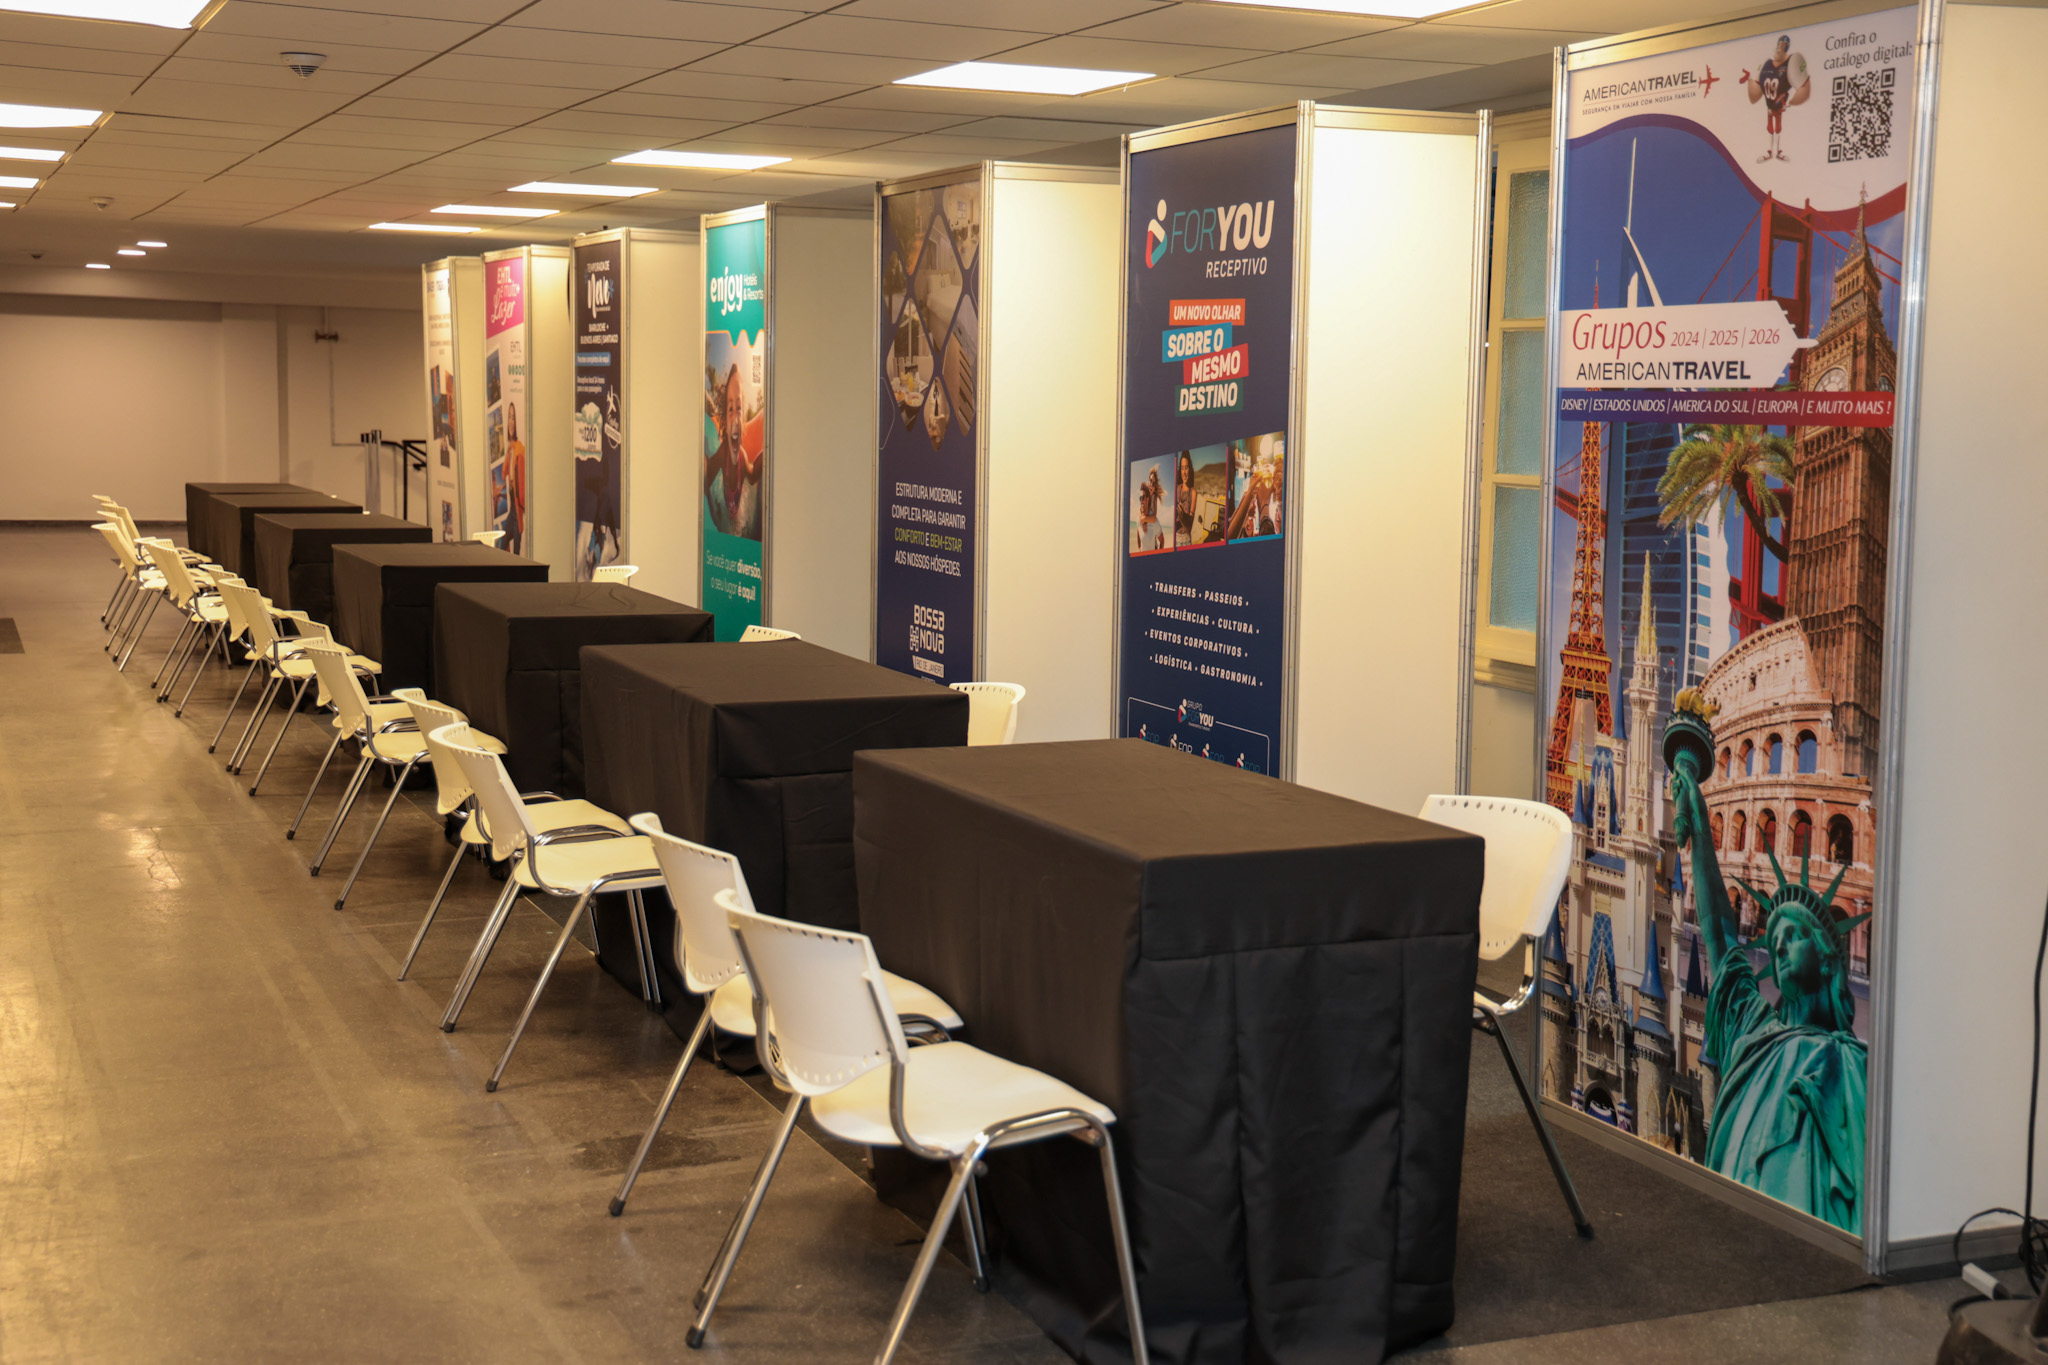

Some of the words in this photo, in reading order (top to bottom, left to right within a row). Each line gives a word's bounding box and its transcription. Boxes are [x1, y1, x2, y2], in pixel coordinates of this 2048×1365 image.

[1825, 32, 1866, 51] Confira
[1869, 32, 1877, 43] o
[1824, 51, 1870, 70] catálogo
[1873, 41, 1913, 64] digital:
[1583, 71, 1697, 102] AMERICANTRAVEL
[1582, 105, 1611, 116] SEGURANÇA
[1622, 101, 1639, 109] VIAJAR
[1655, 95, 1673, 103] NOSSA
[1675, 91, 1696, 100] FAMÍLIA
[1170, 200, 1275, 254] FORYOU
[1206, 256, 1268, 279] RECEPTIVO
[710, 266, 743, 316] enjoy
[1173, 305, 1187, 321] UM
[1187, 305, 1210, 321] NOVO
[1211, 304, 1241, 320] OLHAR
[1167, 329, 1212, 358] SOBRE
[1213, 328, 1224, 352] O
[1572, 313, 1667, 360] Grupos
[1670, 331, 1699, 347] 2024
[1709, 330, 1739, 346] 2025
[1748, 328, 1780, 345] 2026
[1191, 350, 1241, 385] MESMO
[1576, 361, 1751, 381] AMERICANTRAVEL
[1179, 382, 1238, 412] DESTINO
[1560, 398, 1588, 411] DISNEY
[1593, 399, 1631, 412] ESTADOS
[1632, 399, 1665, 412] UNIDOS
[1671, 399, 1712, 413] AMERICA
[1714, 400, 1730, 413] DO
[1731, 400, 1750, 413] SUL
[1757, 400, 1799, 414] EUROPA
[1806, 400, 1814, 414] E
[1815, 400, 1853, 414] MUITO
[895, 482, 928, 500] ESTRUTURA
[928, 486, 958, 505] MODERNA
[957, 490, 962, 506] E
[891, 504, 921, 522] COMPLETA
[921, 508, 937, 525] PARA
[937, 511, 966, 530] GARANTIR
[894, 527, 925, 546] CONFORTO
[925, 532, 930, 547] E
[930, 533, 963, 553] BEM-ESTAR
[894, 549, 907, 565] AOS
[906, 552, 930, 570] NOSSOS
[1155, 581, 1196, 599] TRANSFERS
[1204, 590, 1243, 607] PASSEIOS
[1156, 606, 1210, 626] EXPERIÊNCIAS
[1217, 618, 1253, 635] CULTURA
[1149, 628, 1182, 645] EVENTOS
[1183, 635, 1242, 658] CORPORATIVOS
[1154, 653, 1193, 672] LOGÍSTICA
[1200, 664, 1257, 687] GASTRONOMIA
[1187, 700, 1203, 712] GRUPO
